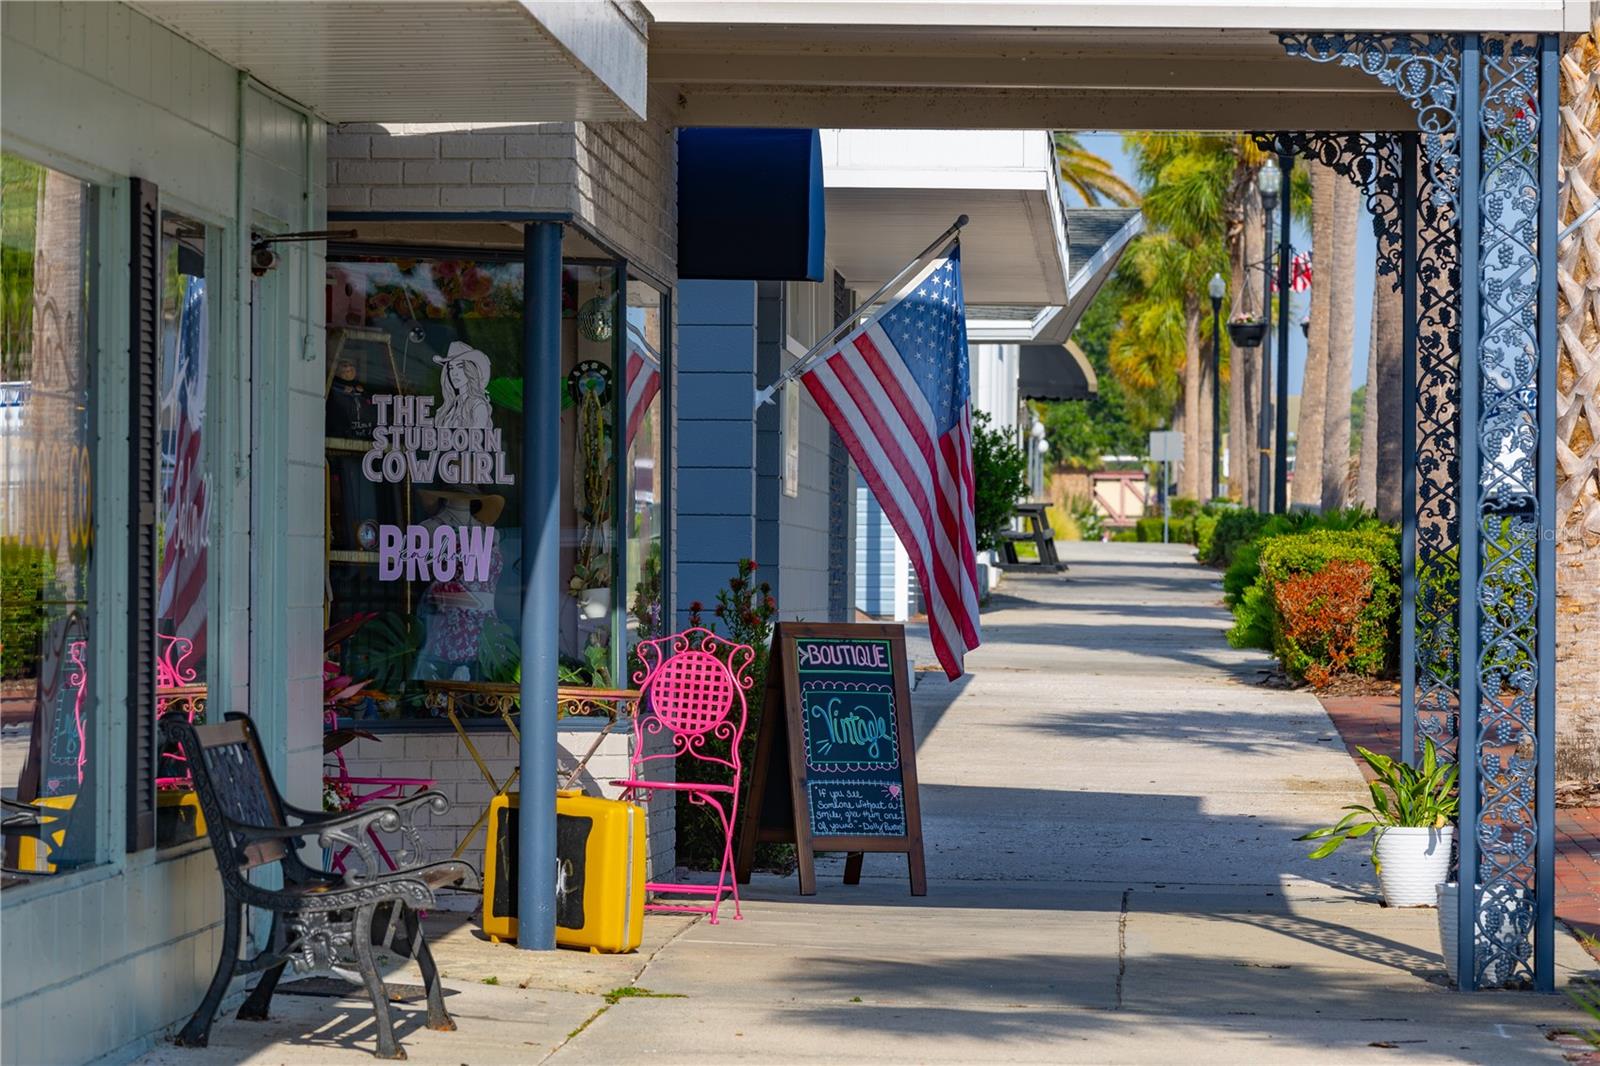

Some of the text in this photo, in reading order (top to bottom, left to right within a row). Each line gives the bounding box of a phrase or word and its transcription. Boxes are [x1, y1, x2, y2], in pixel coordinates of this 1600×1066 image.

[371, 394, 434, 427] THE
[372, 426, 502, 451] STUBBORN
[361, 450, 515, 485] COWGIRL
[379, 524, 495, 582] BROW
[807, 644, 888, 667] BOUTIQUE
[811, 697, 892, 758] Vintage
[829, 790, 844, 804] you
[846, 790, 863, 799] see
[855, 799, 887, 812] without
